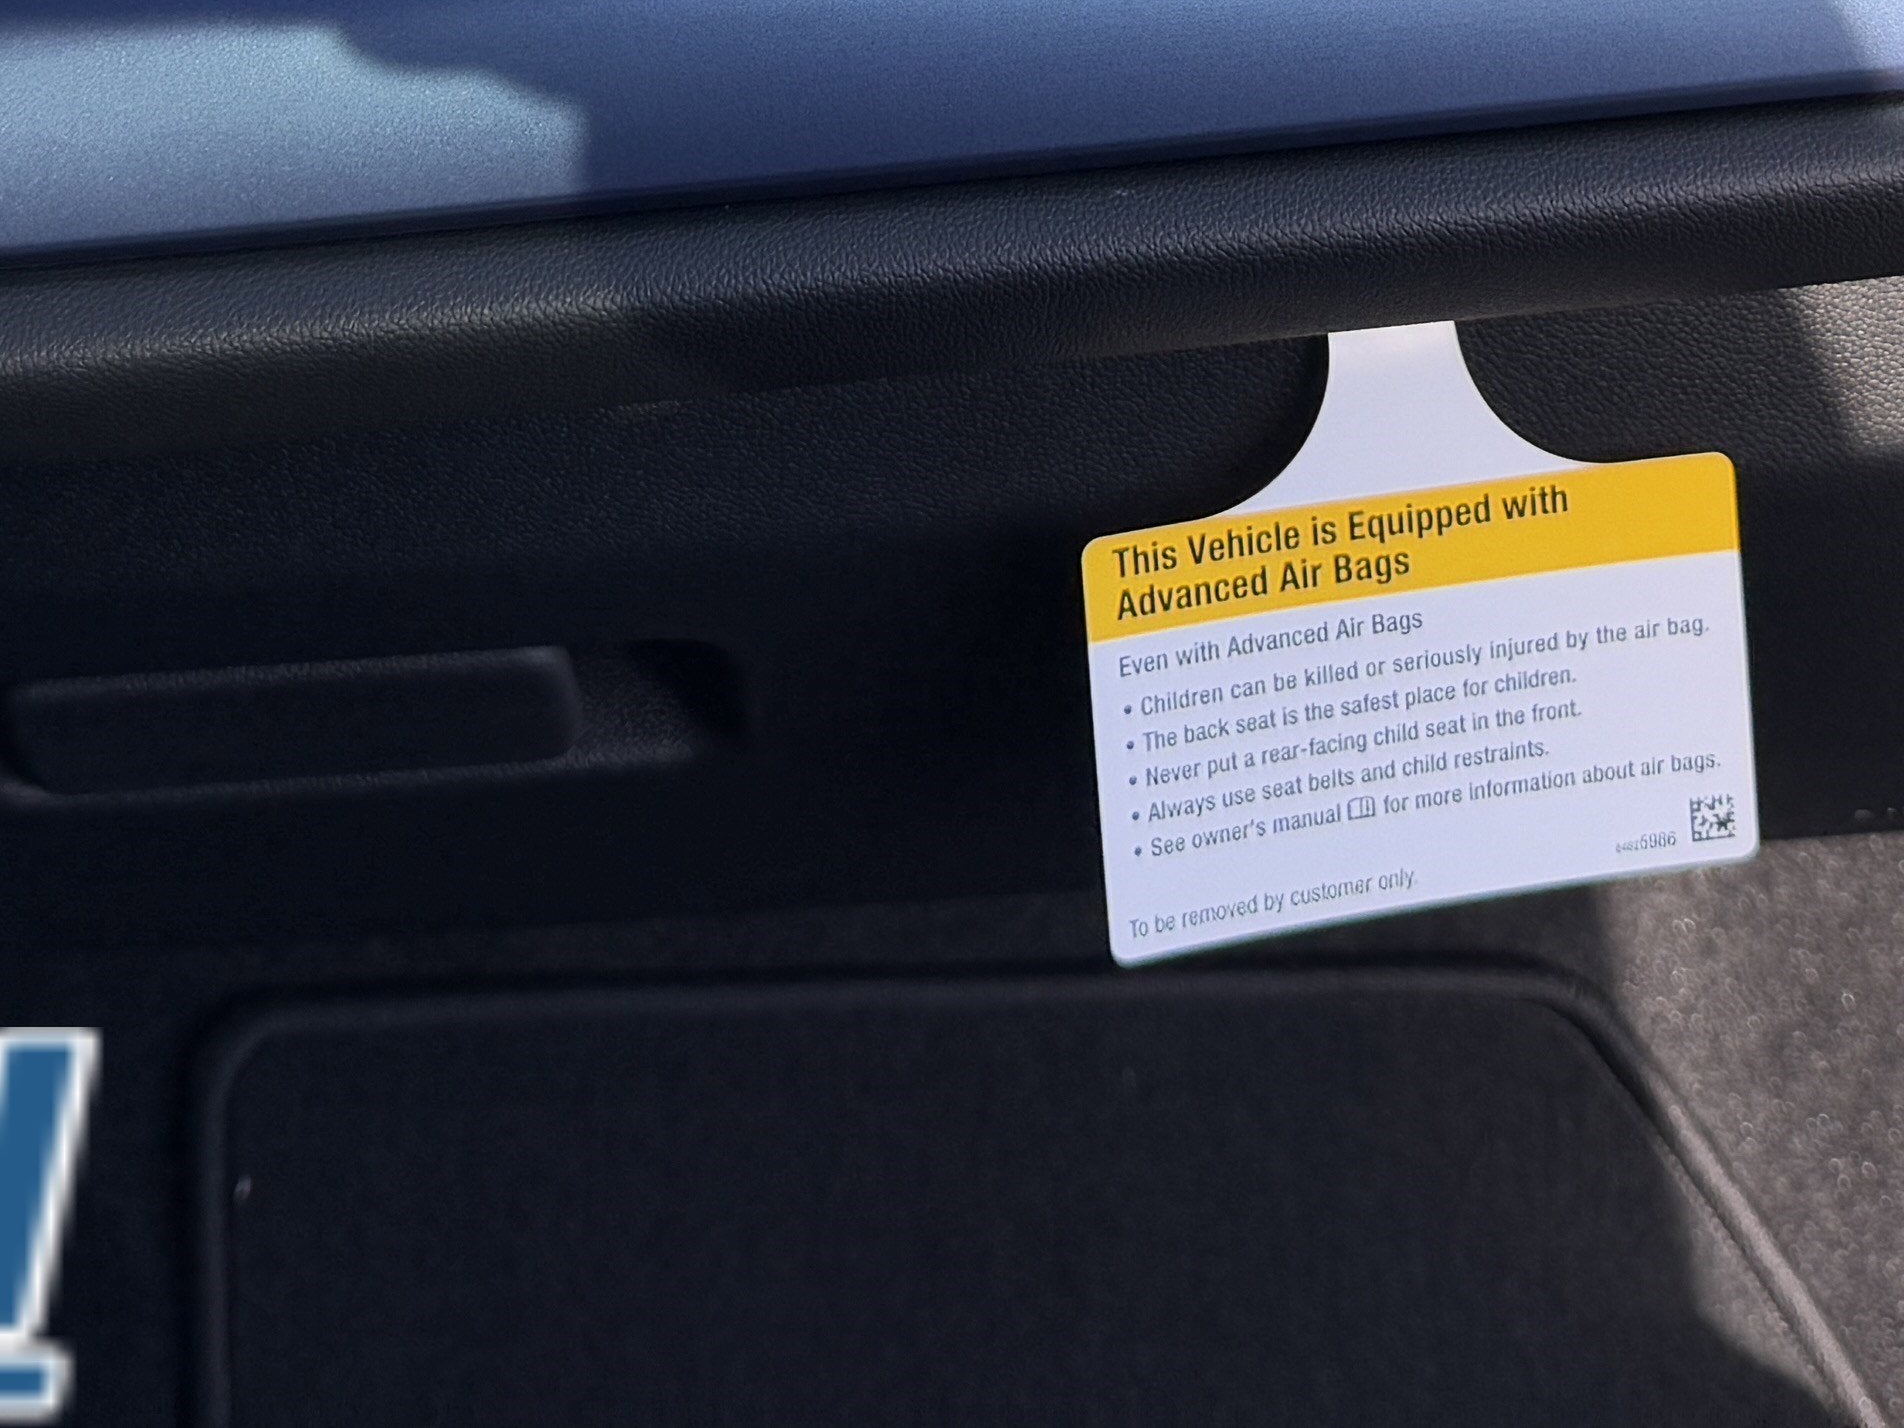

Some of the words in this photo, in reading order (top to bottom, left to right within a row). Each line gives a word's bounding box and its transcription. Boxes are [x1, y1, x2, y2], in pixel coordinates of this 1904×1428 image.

[1112, 542, 1178, 579] This
[1187, 521, 1301, 566] Vehicle
[1311, 515, 1337, 546] is
[1348, 492, 1492, 545] Equipped
[1502, 483, 1569, 521] with
[1117, 565, 1269, 622] Advanced
[1280, 557, 1324, 593] Air
[1334, 549, 1411, 587] Bags
[1119, 651, 1169, 678] Even
[1176, 640, 1221, 666] with
[1227, 621, 1329, 657] Advanced
[1335, 616, 1365, 641] Air
[1372, 610, 1424, 635] Bags
[1141, 684, 1224, 716] Children
[1230, 678, 1267, 699] can
[1273, 672, 1298, 692] be
[1304, 659, 1360, 688] killed
[1365, 659, 1386, 678] or
[1392, 643, 1484, 674] seriously
[1489, 630, 1559, 662] injured
[1565, 628, 1589, 652] by
[1595, 624, 1628, 645] the
[1634, 618, 1660, 641] air
[1666, 615, 1711, 637] bag.
[1143, 728, 1178, 752] The
[1183, 717, 1230, 745] back
[1235, 709, 1277, 734] seat
[1282, 705, 1299, 727] is
[1304, 701, 1335, 722] the
[1339, 689, 1400, 717] safest
[1405, 684, 1456, 711] place
[1462, 677, 1490, 697] for
[1494, 665, 1577, 694] children.
[1145, 762, 1202, 787] Never
[1206, 752, 1238, 780] put
[1244, 750, 1256, 770] a
[1260, 732, 1368, 766] rear-facing
[1373, 721, 1420, 747] child
[1424, 713, 1467, 739] seat
[1471, 710, 1490, 733] in
[1495, 706, 1526, 728] the
[1531, 698, 1582, 724] front.
[1148, 792, 1216, 824] Always
[1221, 786, 1256, 810] use
[1261, 775, 1304, 801] seat
[1308, 766, 1356, 793] belts
[1360, 760, 1396, 784] and
[1401, 751, 1447, 779] child
[1452, 737, 1549, 770] restraints.
[1150, 834, 1186, 858] See
[1191, 818, 1267, 850] owner's
[1272, 802, 1343, 835] manual
[1382, 792, 1410, 815] for
[1414, 785, 1463, 810] more
[1468, 769, 1577, 801] information
[1582, 757, 1636, 785] about
[1640, 754, 1664, 777] air
[1670, 750, 1722, 775] bags.
[1130, 918, 1149, 940] To
[1154, 912, 1176, 934] be
[1181, 894, 1258, 928] removed
[1263, 892, 1284, 914] by
[1289, 873, 1373, 907] customer
